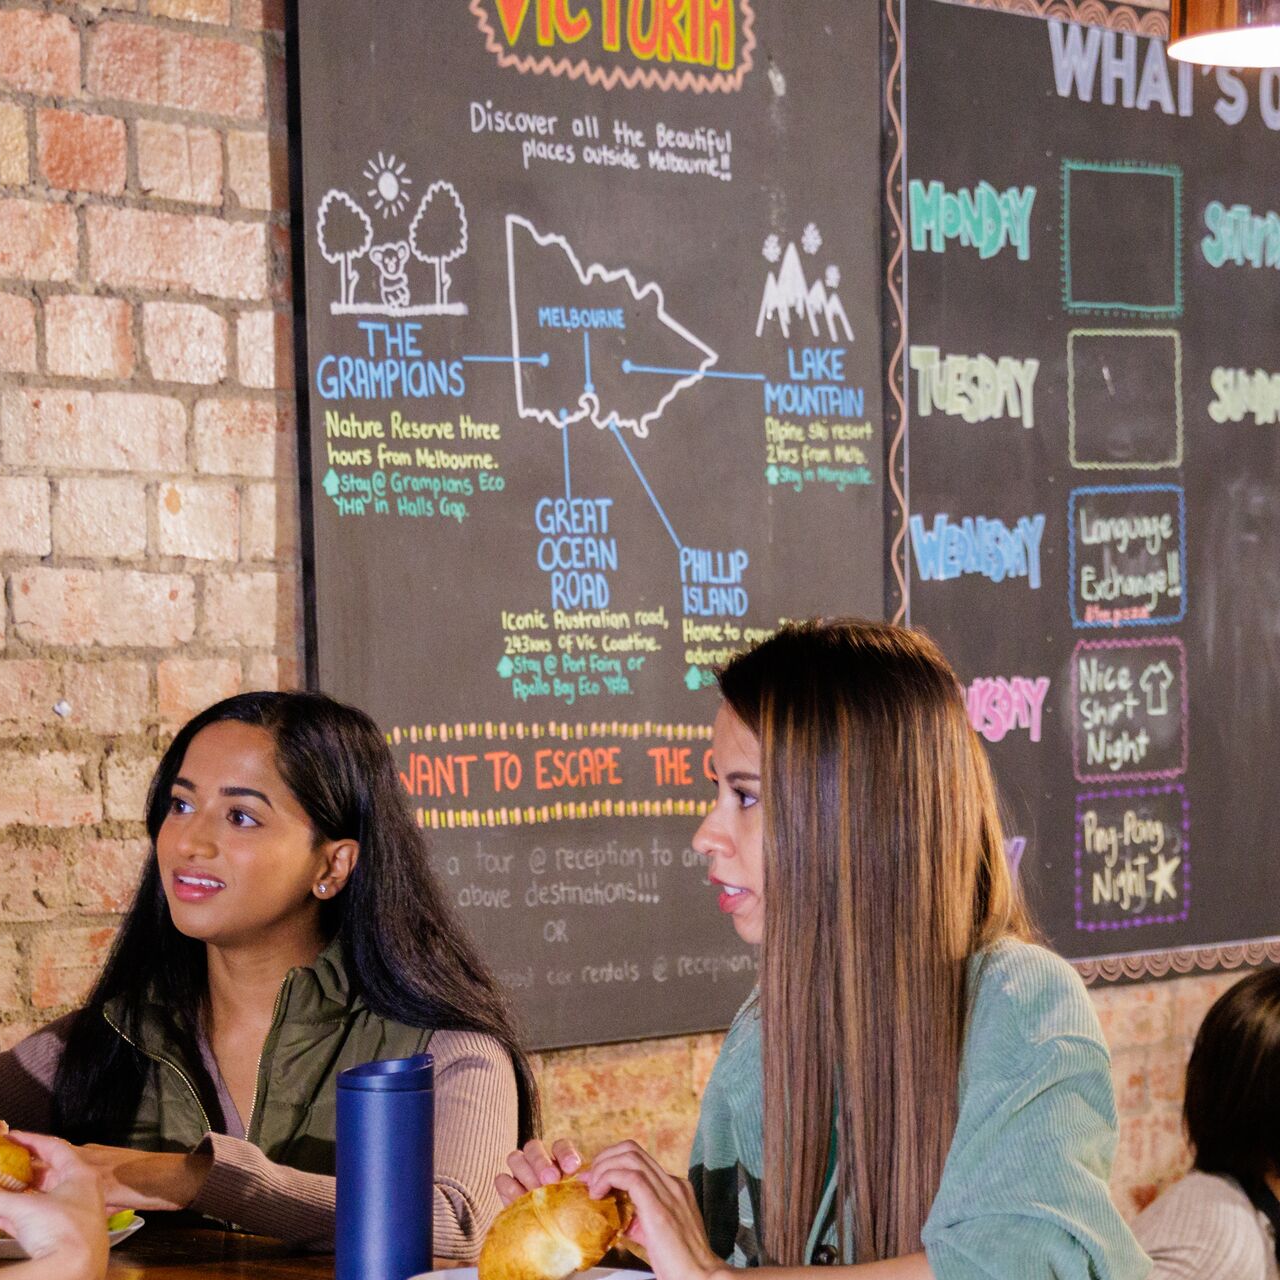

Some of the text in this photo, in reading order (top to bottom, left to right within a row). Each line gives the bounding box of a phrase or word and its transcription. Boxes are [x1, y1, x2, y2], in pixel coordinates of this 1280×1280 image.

[470, 100, 732, 158] Discover all the Beautiful
[522, 138, 575, 169] places
[583, 146, 641, 170] outside
[909, 179, 1037, 261] MONDAY
[538, 306, 625, 329] MELBOURNE
[358, 320, 423, 357] THE
[316, 355, 465, 399] GRAMPIANS
[787, 347, 846, 381] LAKE
[764, 382, 864, 417] MOUNTAIN
[909, 345, 1040, 429] TUESDAY
[325, 410, 501, 440] Nature Reserve three
[327, 441, 499, 469] hours from Melbourne.
[390, 471, 473, 499] Grampians
[478, 471, 505, 492] Eco
[333, 496, 366, 516] YHA
[375, 496, 389, 515] in
[397, 497, 434, 517] Halls
[535, 497, 613, 534] GREAT
[537, 537, 618, 571] OCEAN
[679, 547, 749, 583] PHILLIP
[551, 571, 609, 609] ROAD
[682, 584, 748, 617] ISLAND
[501, 610, 549, 631] Iconic
[553, 609, 630, 631] Australian
[682, 617, 723, 643] Home
[724, 622, 741, 642] to
[576, 634, 597, 650] Vic
[627, 656, 646, 672] or
[1079, 657, 1132, 694] Nice
[1086, 727, 1151, 771] Night
[484, 751, 522, 792] TO
[535, 747, 622, 790] ESCAPE
[647, 747, 693, 786] THE
[476, 841, 514, 874] tour
[555, 841, 645, 876] reception
[652, 838, 673, 867] to
[458, 884, 512, 909] above
[543, 918, 569, 943] OR
